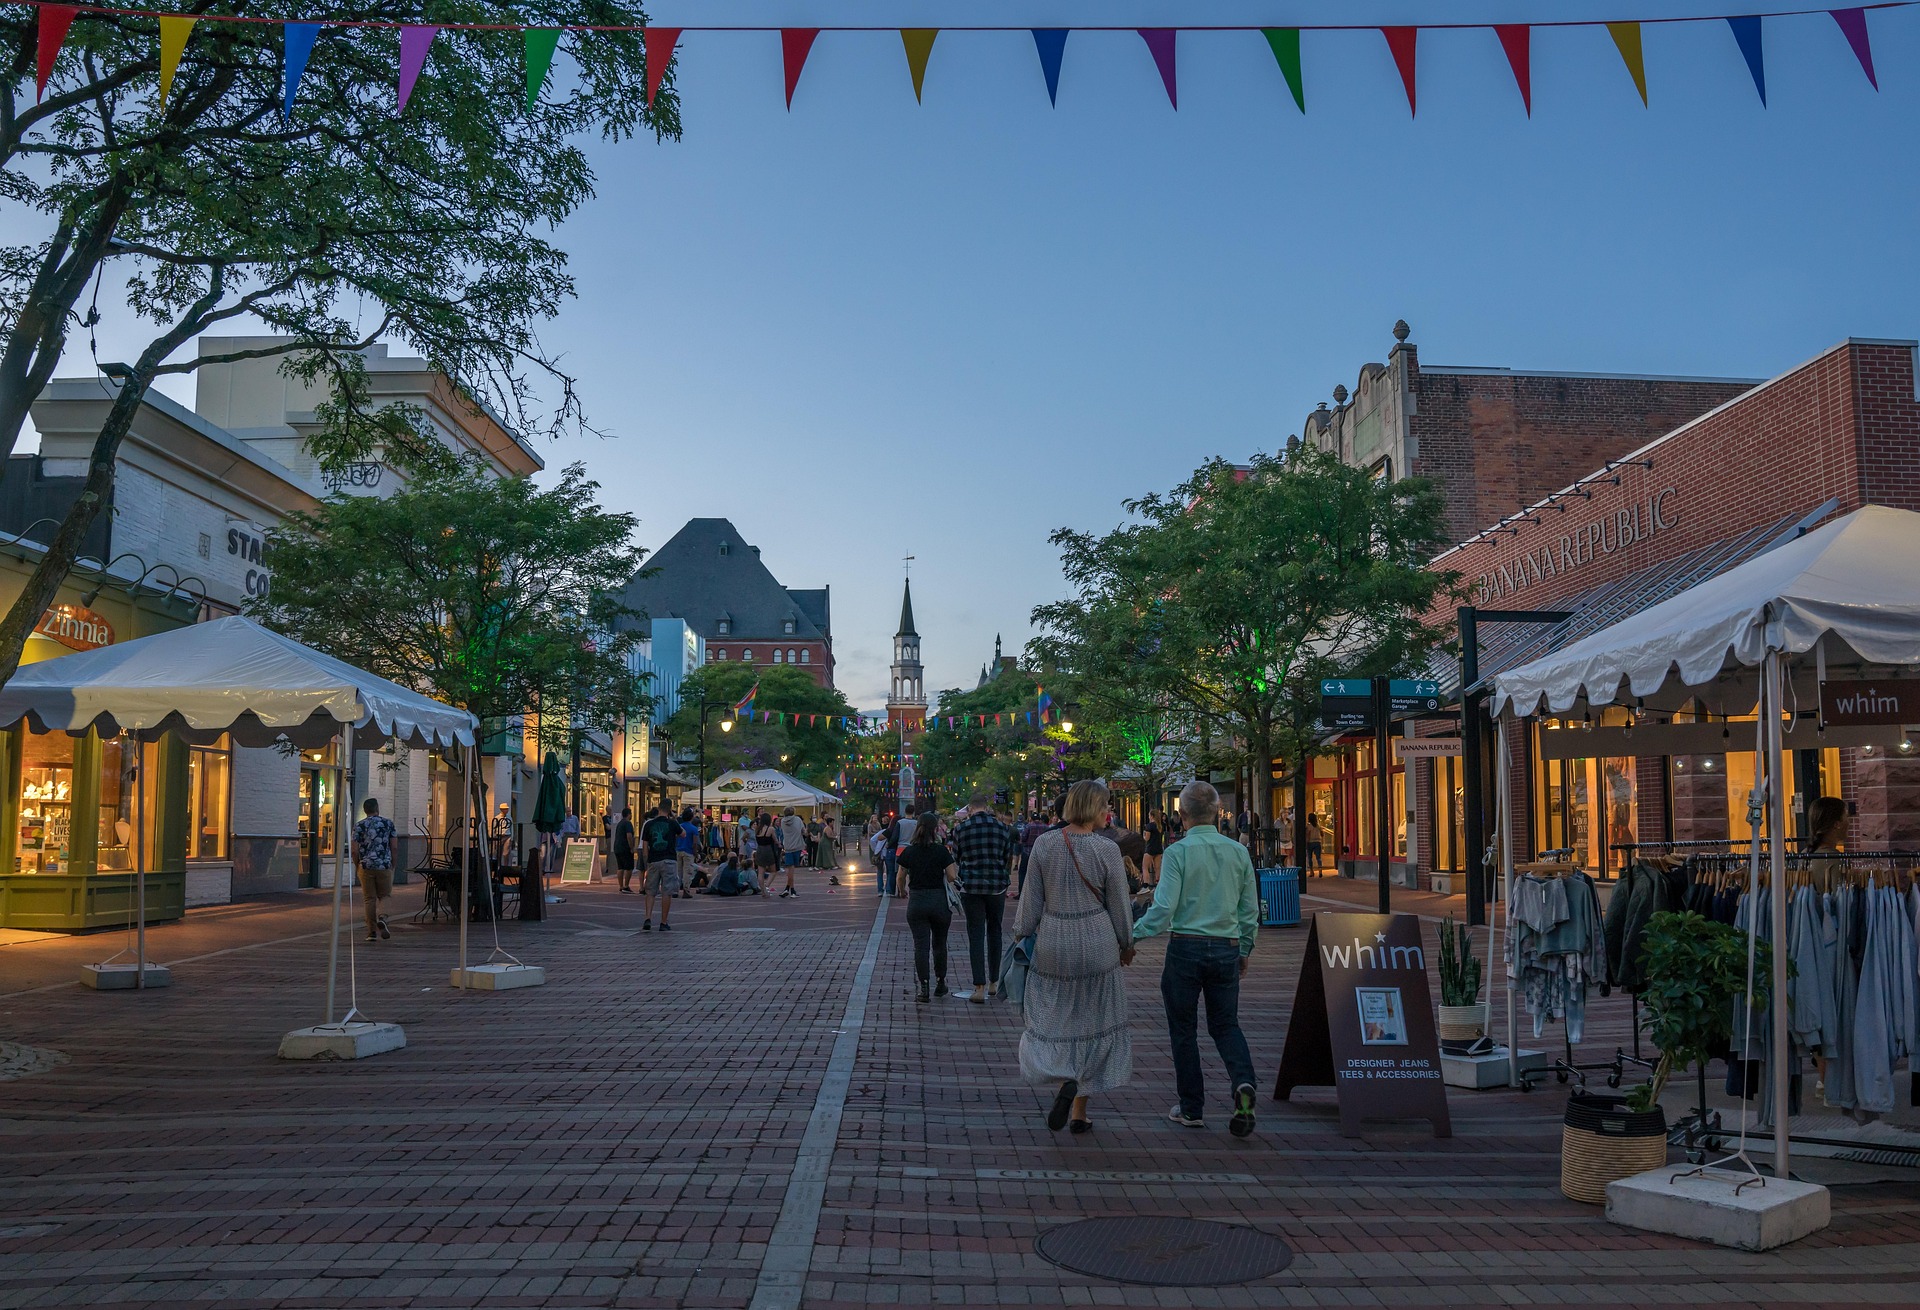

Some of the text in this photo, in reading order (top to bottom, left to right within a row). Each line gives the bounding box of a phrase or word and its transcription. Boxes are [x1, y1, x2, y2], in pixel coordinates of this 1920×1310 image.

[1478, 486, 1679, 606] BANANA REPUBLIC
[43, 608, 109, 646] Zinnia
[1836, 688, 1899, 714] whim
[744, 784, 777, 792] Gear
[54, 826, 70, 835] LIVES
[1321, 930, 1425, 970] whim
[1347, 1059, 1430, 1068] DESIGNER JEANS
[1339, 1070, 1441, 1079] TEES & ACCESSORIES
